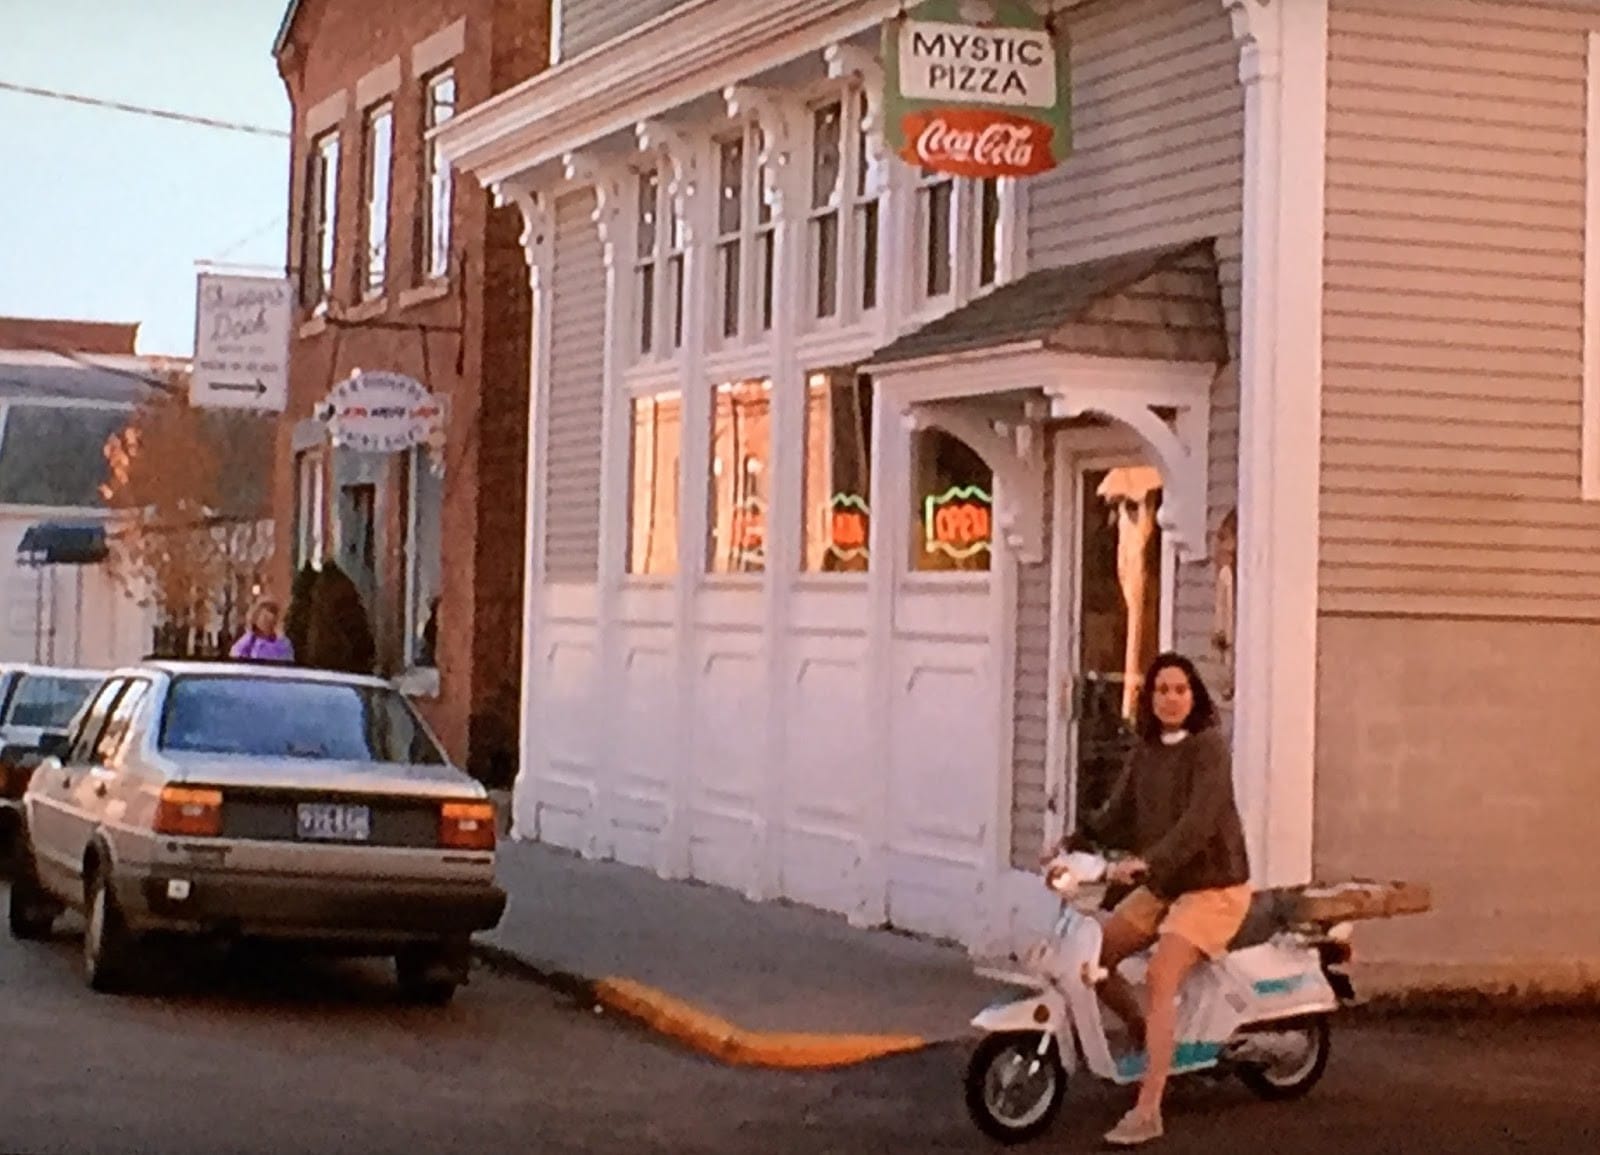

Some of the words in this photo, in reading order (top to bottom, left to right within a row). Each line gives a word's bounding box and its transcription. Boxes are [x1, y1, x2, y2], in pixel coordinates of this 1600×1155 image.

[913, 31, 1043, 67] MYSTIC
[929, 64, 1027, 96] PIZZA
[936, 504, 988, 544] OPEN
